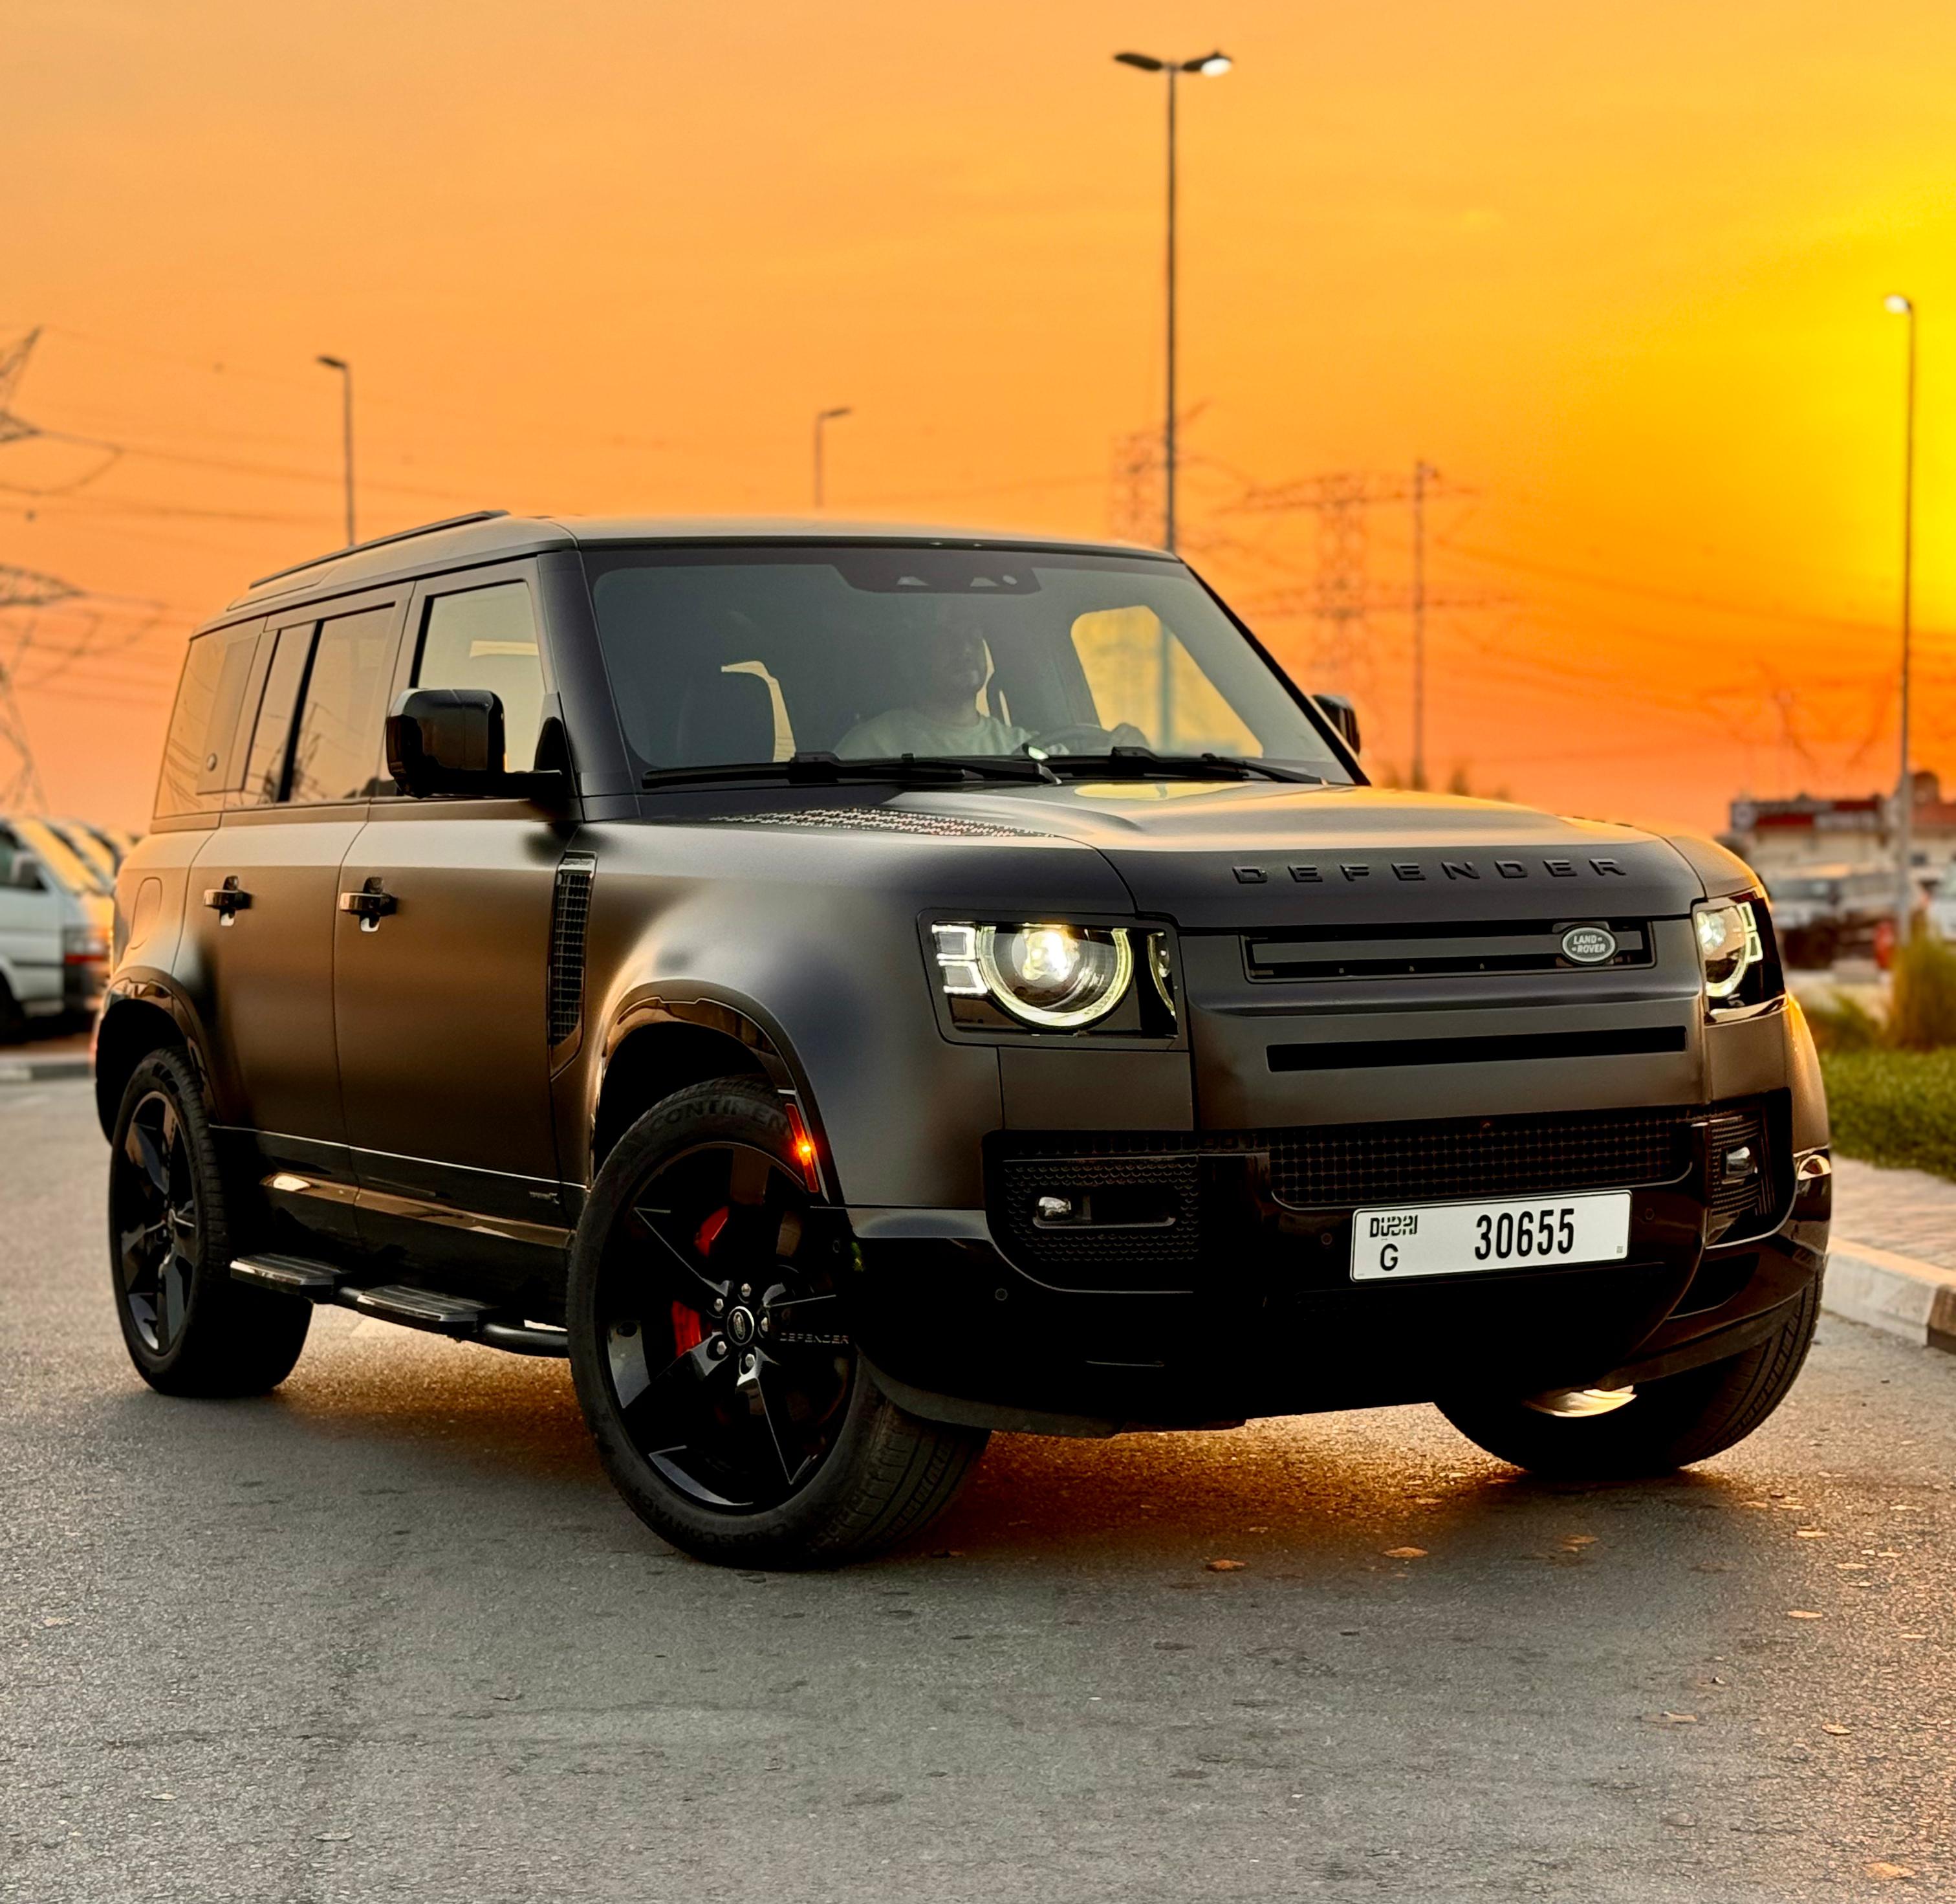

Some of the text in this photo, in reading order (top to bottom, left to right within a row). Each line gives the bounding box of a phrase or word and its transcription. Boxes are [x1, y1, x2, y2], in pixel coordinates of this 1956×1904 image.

[1232, 858, 1626, 884] DEFENDER
[1369, 1214, 1418, 1238] DUBAI
[1475, 1208, 1575, 1260] 30655
[1380, 1243, 1398, 1271] G
